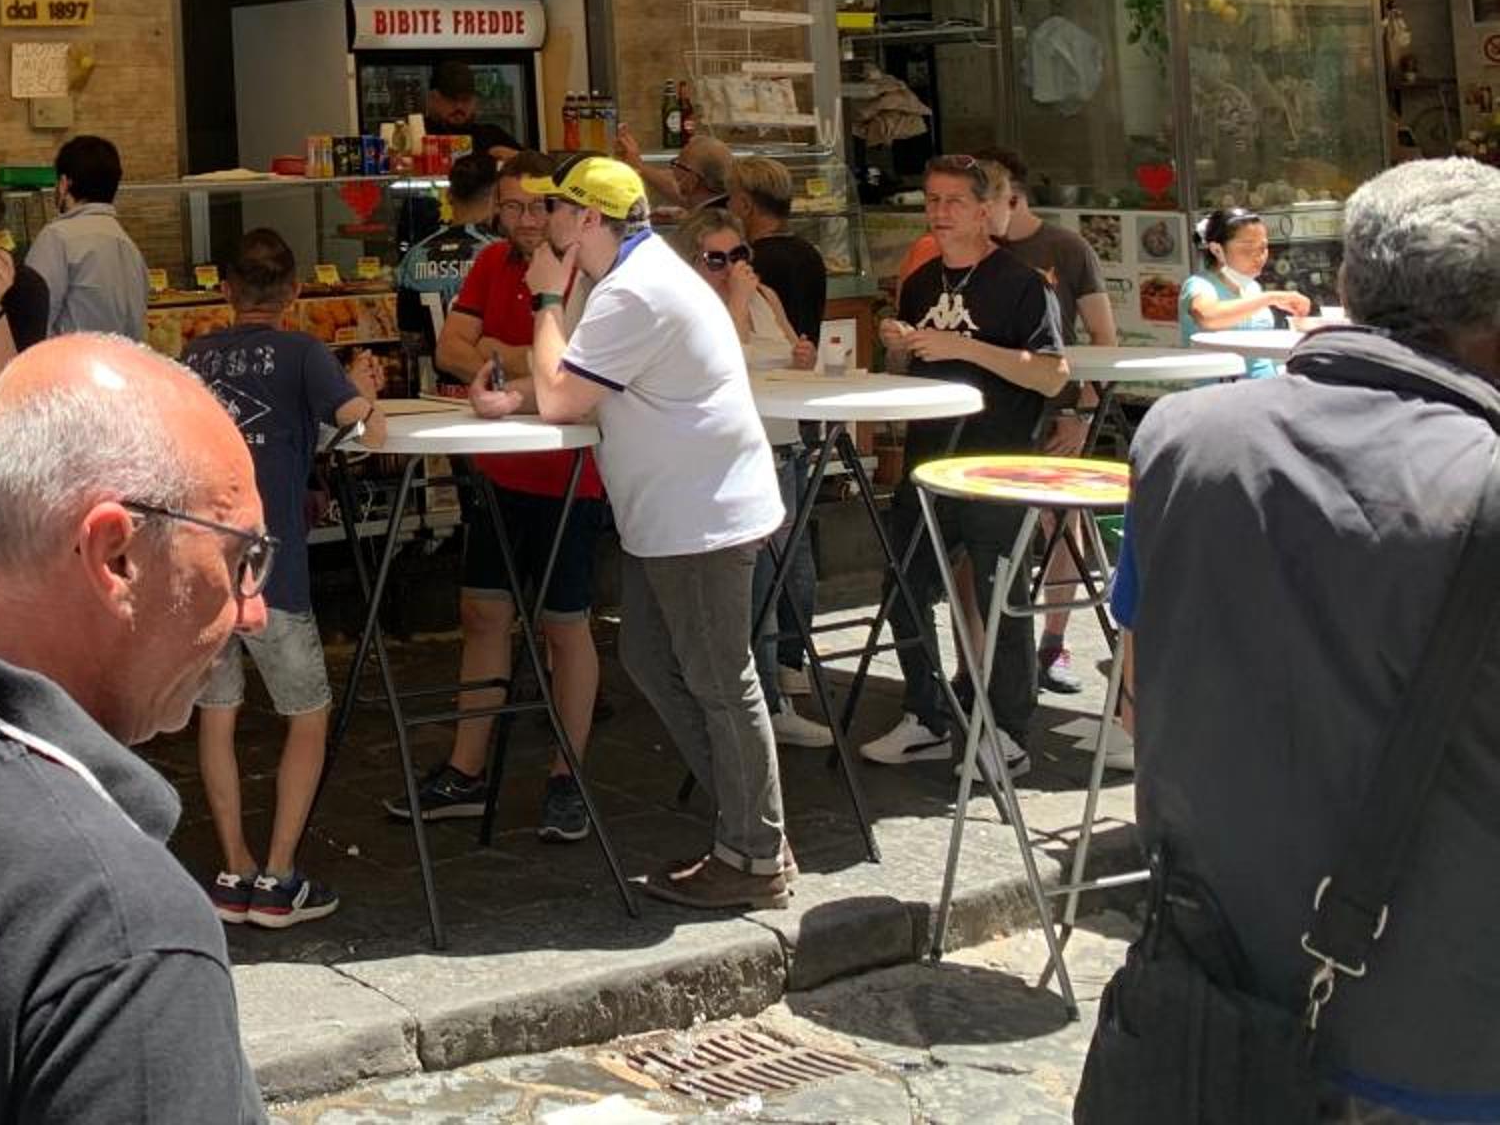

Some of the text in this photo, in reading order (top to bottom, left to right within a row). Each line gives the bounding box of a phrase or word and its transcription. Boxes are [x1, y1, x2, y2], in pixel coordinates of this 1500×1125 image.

[6, 0, 90, 20] dal 1897
[374, 10, 525, 36] BIBITE FREDDE
